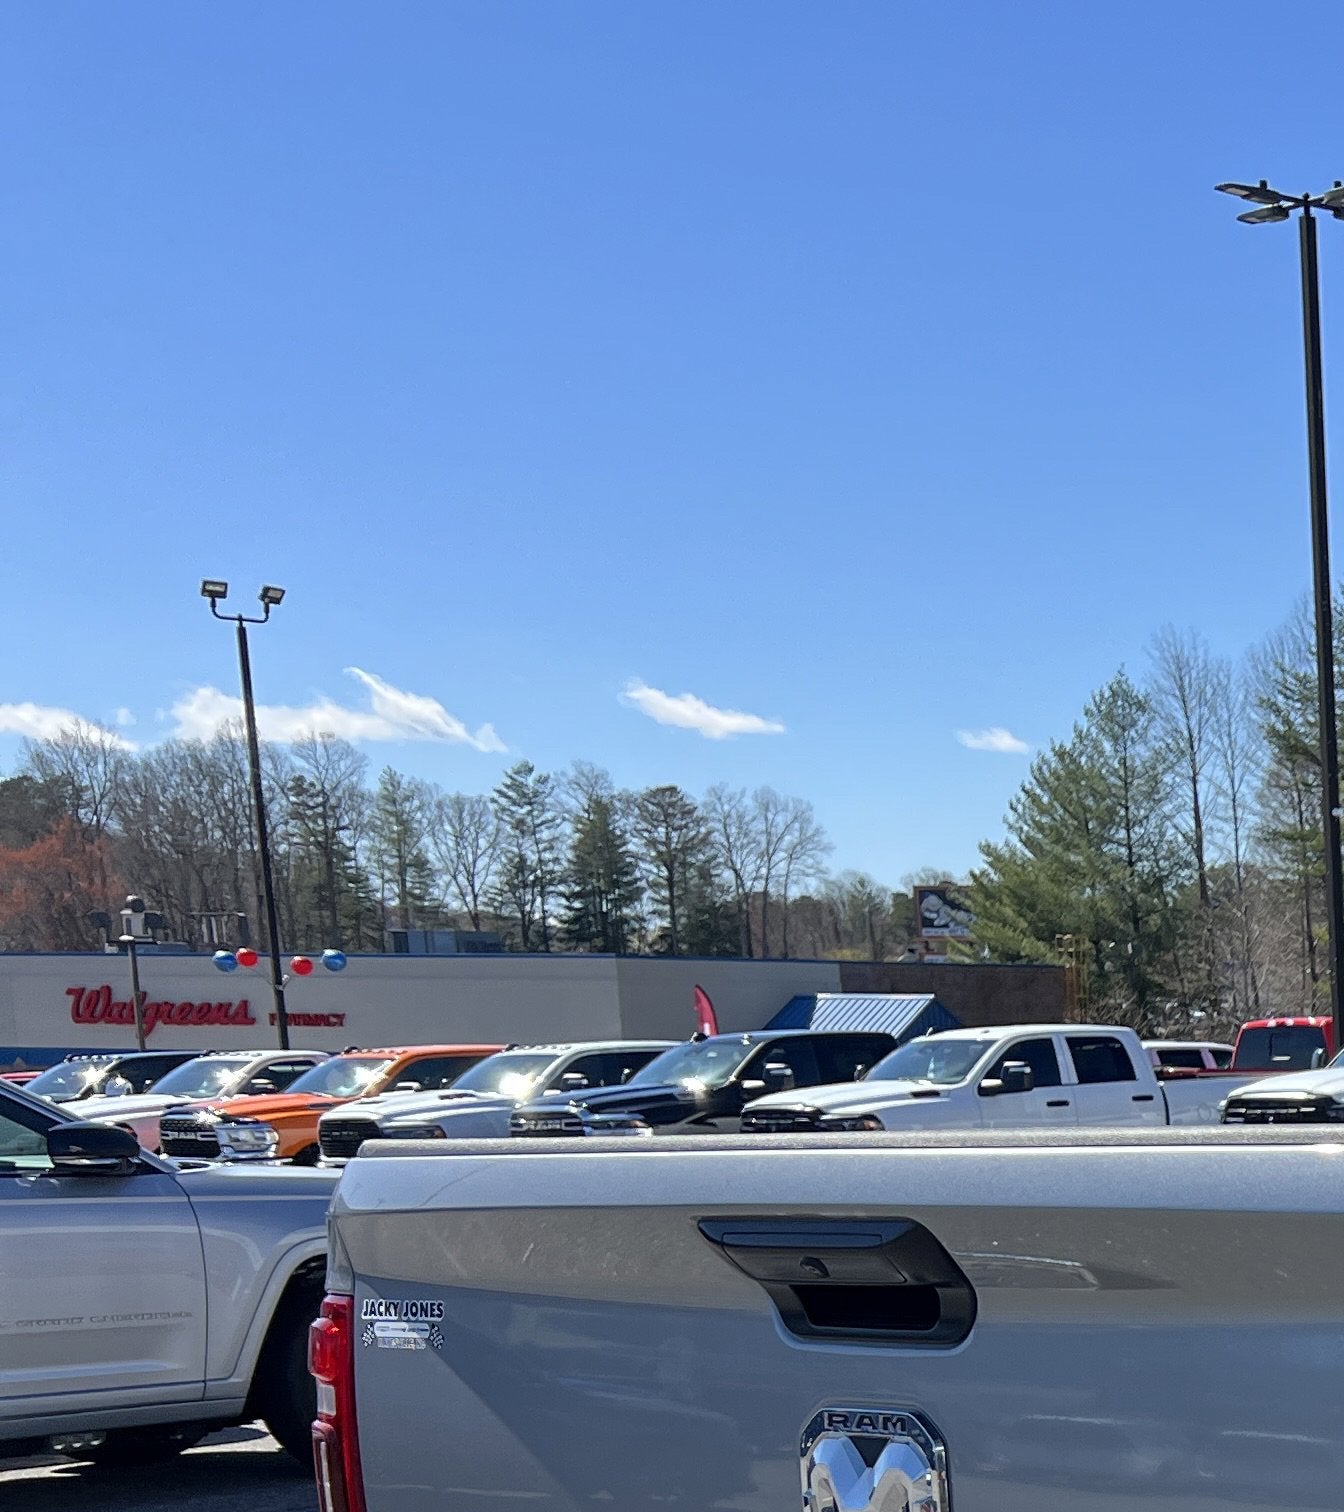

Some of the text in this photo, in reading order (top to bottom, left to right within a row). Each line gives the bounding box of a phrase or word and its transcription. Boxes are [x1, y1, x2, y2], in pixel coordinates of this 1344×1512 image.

[362, 1299, 444, 1320] JACKY JONES
[823, 1411, 908, 1433] RAM
